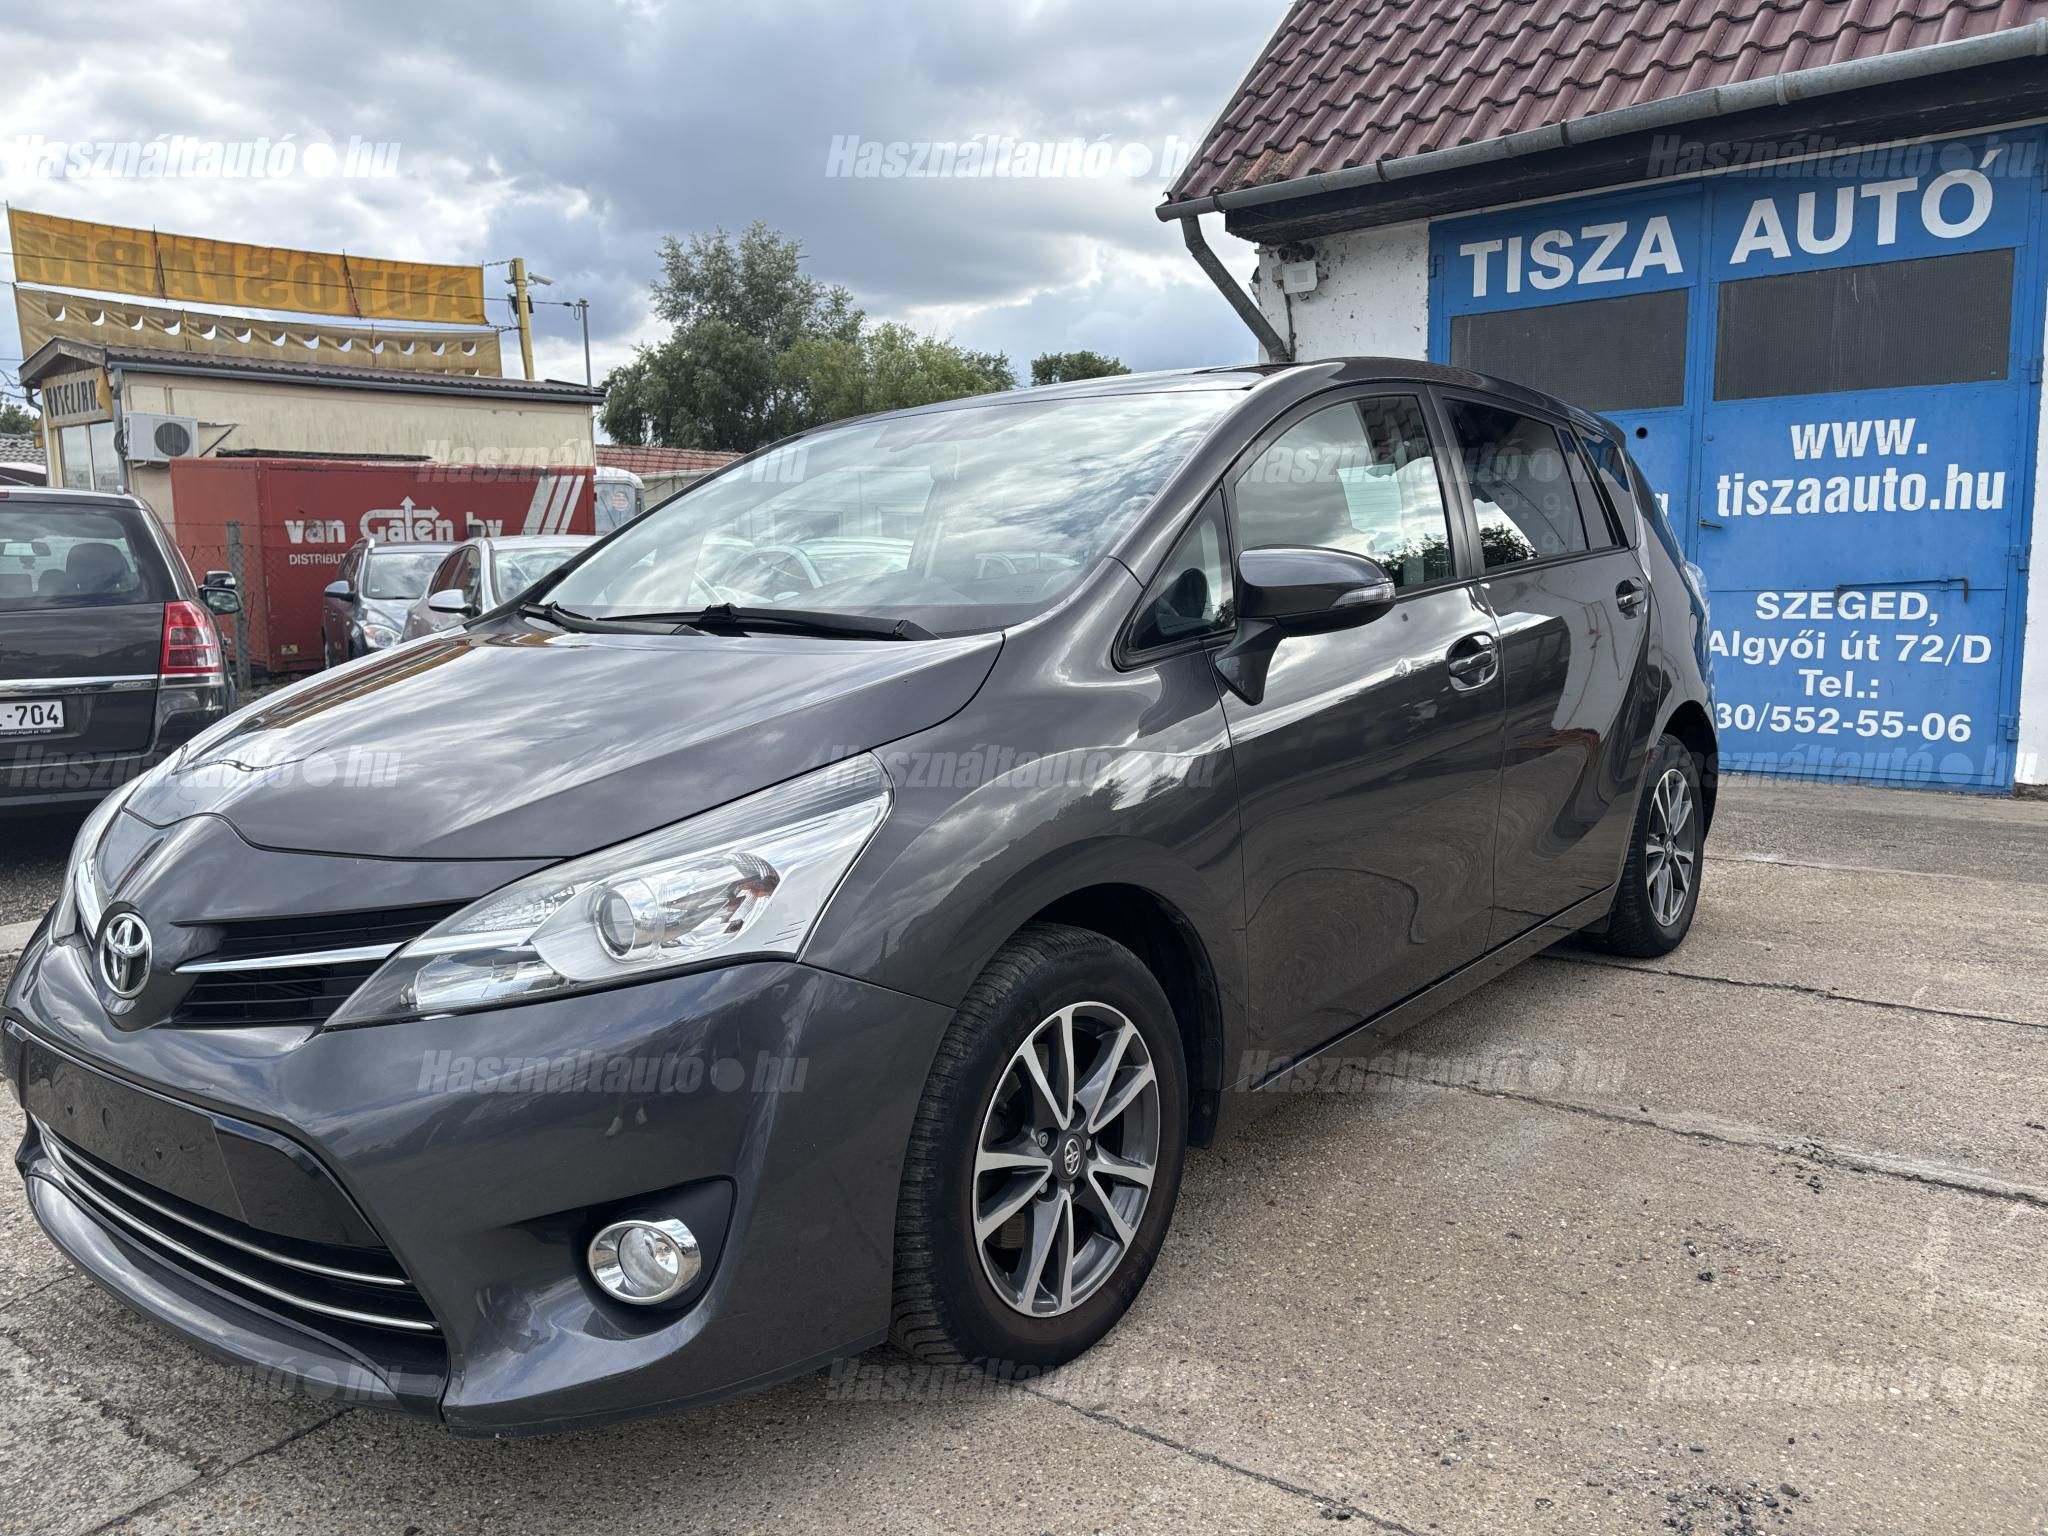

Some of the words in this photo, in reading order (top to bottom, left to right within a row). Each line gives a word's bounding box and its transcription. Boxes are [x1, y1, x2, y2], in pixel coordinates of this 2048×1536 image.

[1460, 216, 1684, 297] TISZA
[1729, 148, 2003, 264] AUTÓ
[1790, 418, 1928, 460] www.
[1717, 464, 2005, 517] tiszaauto.hu
[285, 519, 346, 544] van
[1755, 591, 1939, 627] SZEGED,
[1709, 629, 1826, 666] Algyői
[1840, 630, 1881, 662] út
[1895, 633, 1992, 667] 72/D
[1798, 668, 1880, 699] Tel.:
[0, 704, 59, 728] -704
[1716, 702, 1972, 743] 30/552-55-06
